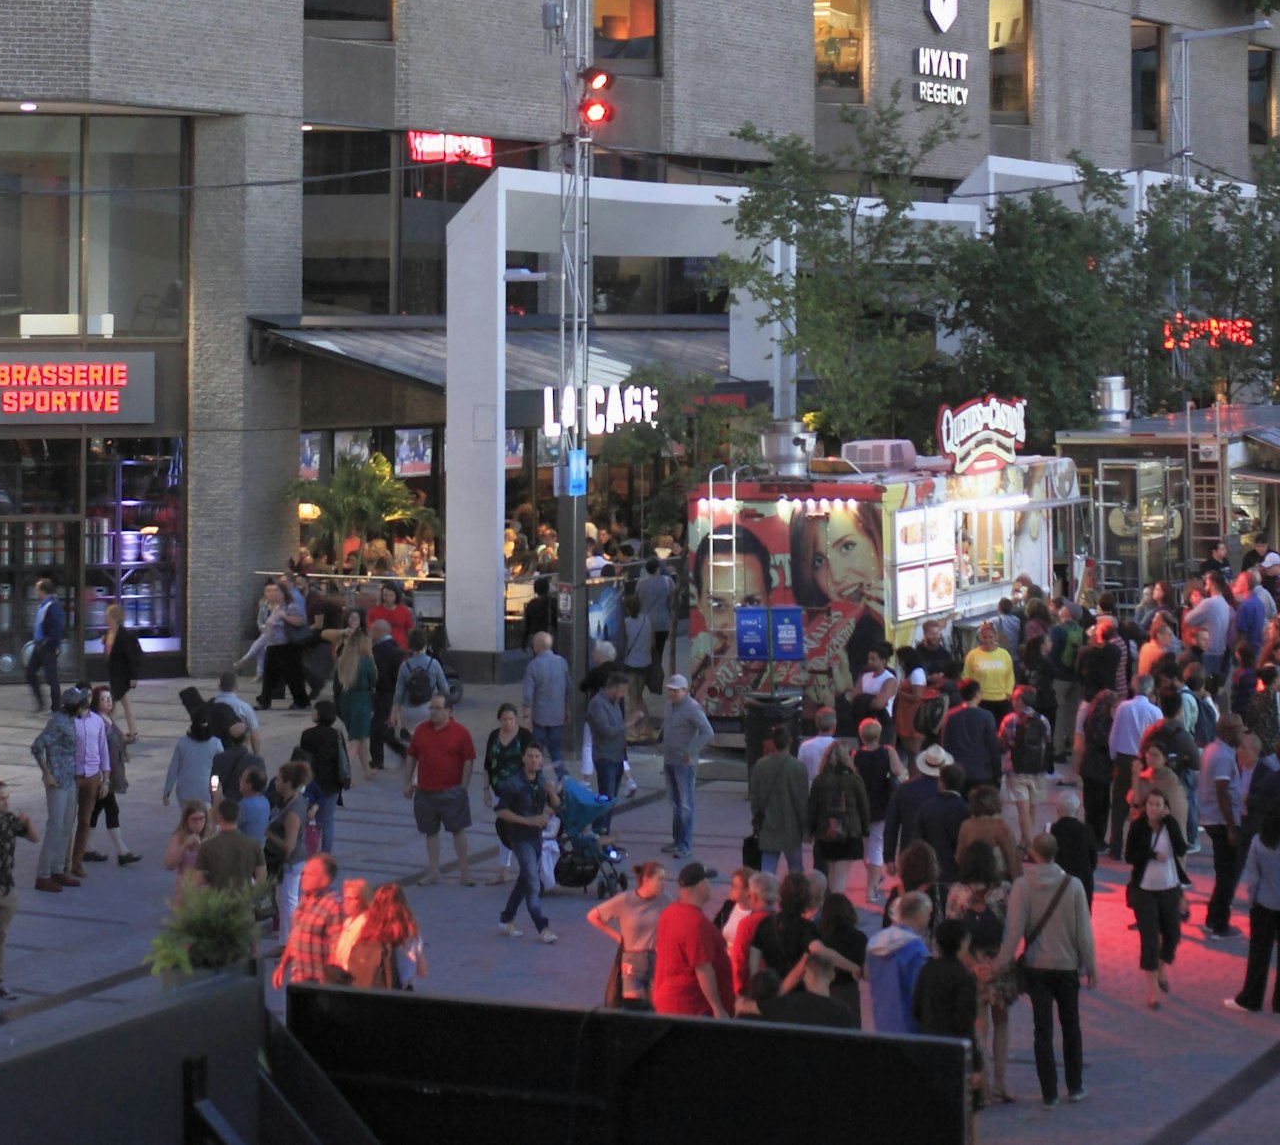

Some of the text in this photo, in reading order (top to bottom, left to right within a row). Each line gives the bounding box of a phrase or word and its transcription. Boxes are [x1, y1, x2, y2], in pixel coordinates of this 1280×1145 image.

[919, 47, 969, 80] HYATT
[919, 81, 969, 105] REGENCY
[2, 390, 119, 414] SPORTIVE
